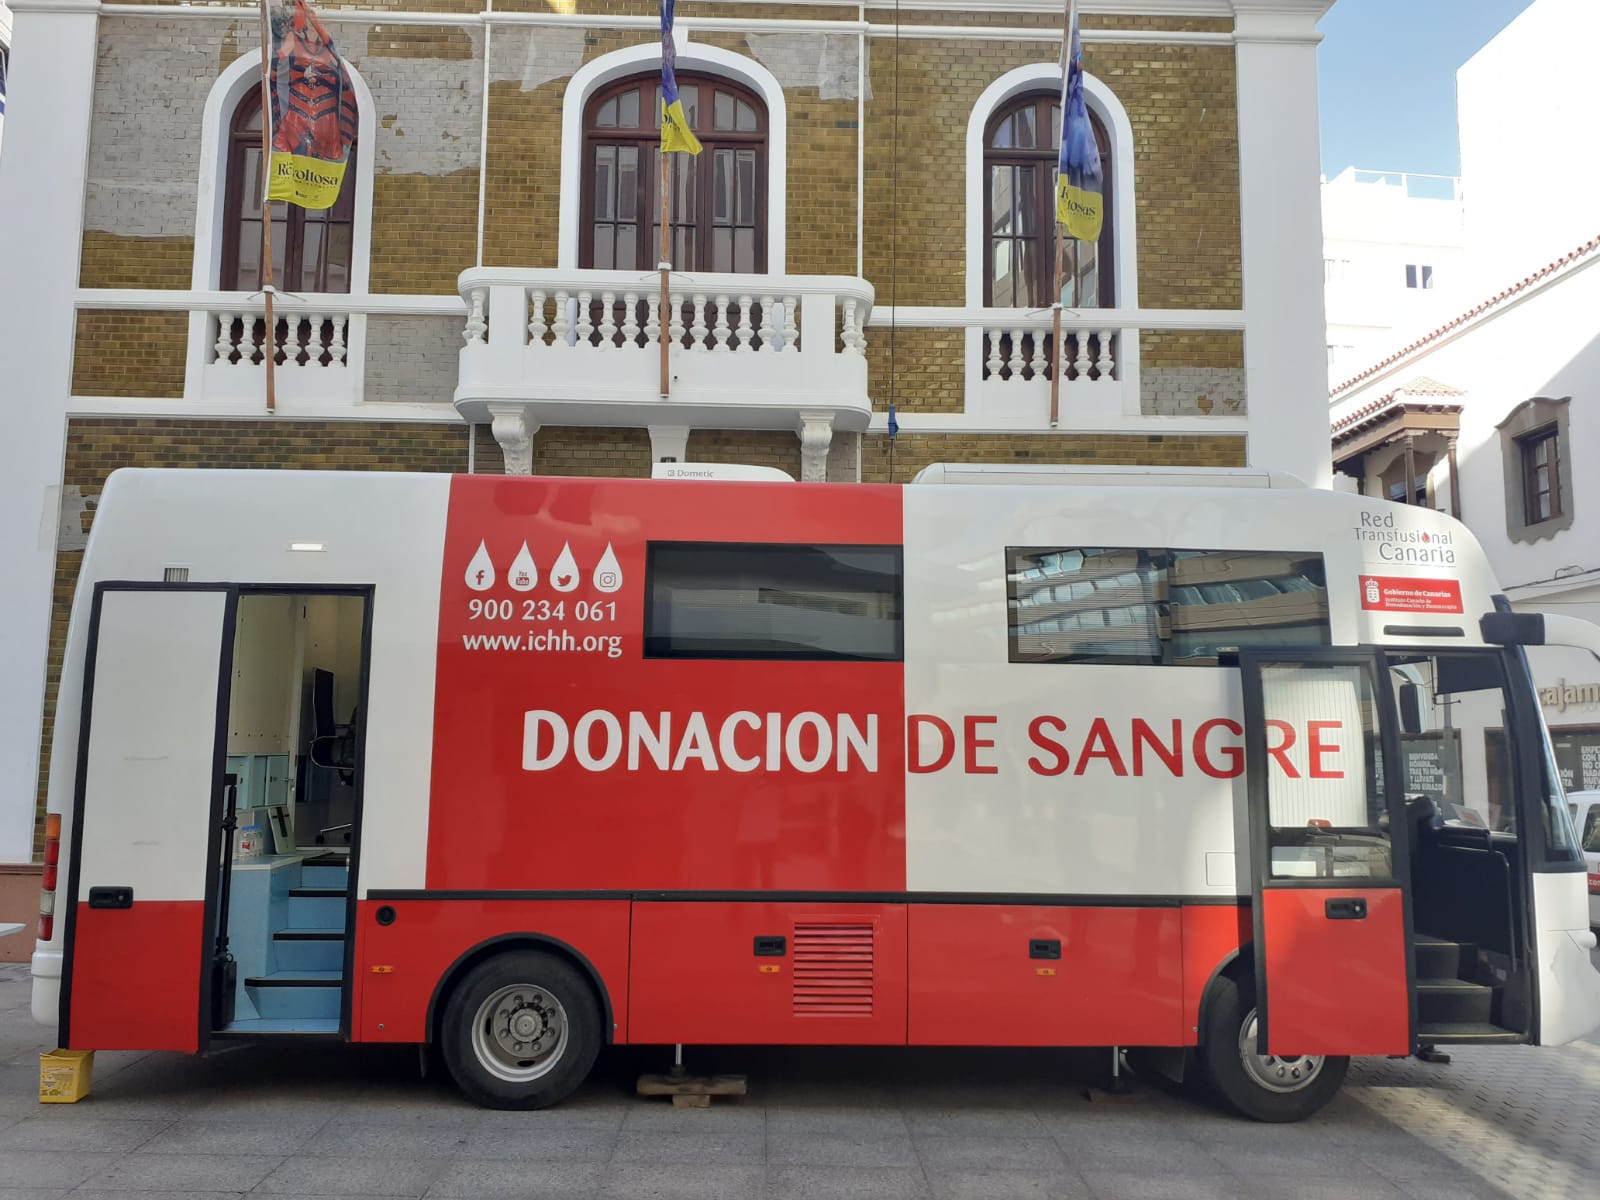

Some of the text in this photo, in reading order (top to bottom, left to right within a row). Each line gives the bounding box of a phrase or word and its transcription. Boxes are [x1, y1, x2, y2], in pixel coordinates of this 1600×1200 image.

[677, 469, 714, 478] Dometic
[1360, 511, 1394, 528] Red
[1379, 542, 1455, 564] Canaria
[468, 598, 616, 622] 900 234 061
[462, 629, 623, 658] www.ichh.org
[522, 709, 878, 773] DONACION
[907, 714, 998, 774] DE
[1027, 715, 1345, 779] SANGRE
